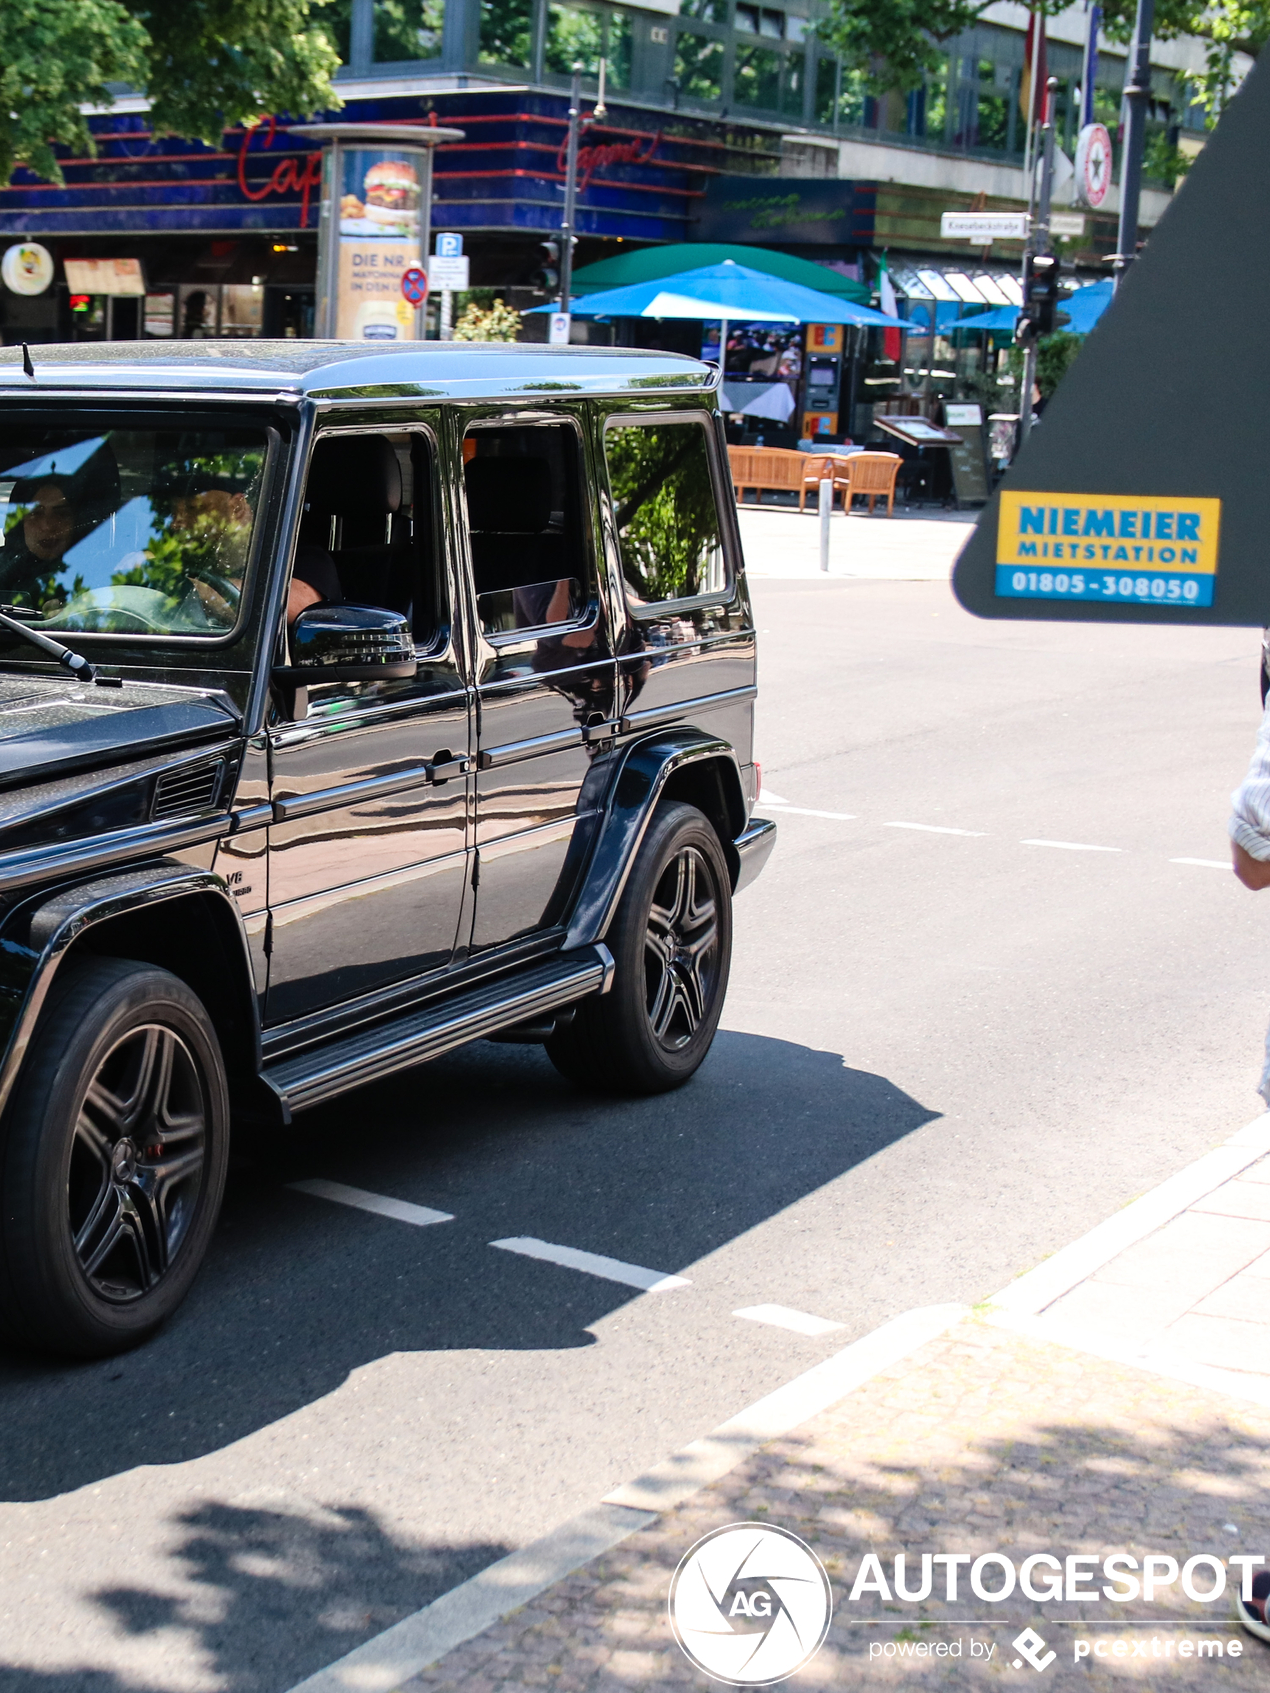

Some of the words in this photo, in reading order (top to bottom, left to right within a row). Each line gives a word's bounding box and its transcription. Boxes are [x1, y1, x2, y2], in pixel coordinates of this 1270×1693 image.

[352, 254, 378, 267] DIE
[1019, 506, 1201, 542] NIEMEIER
[1017, 541, 1198, 564] MIETSTATION
